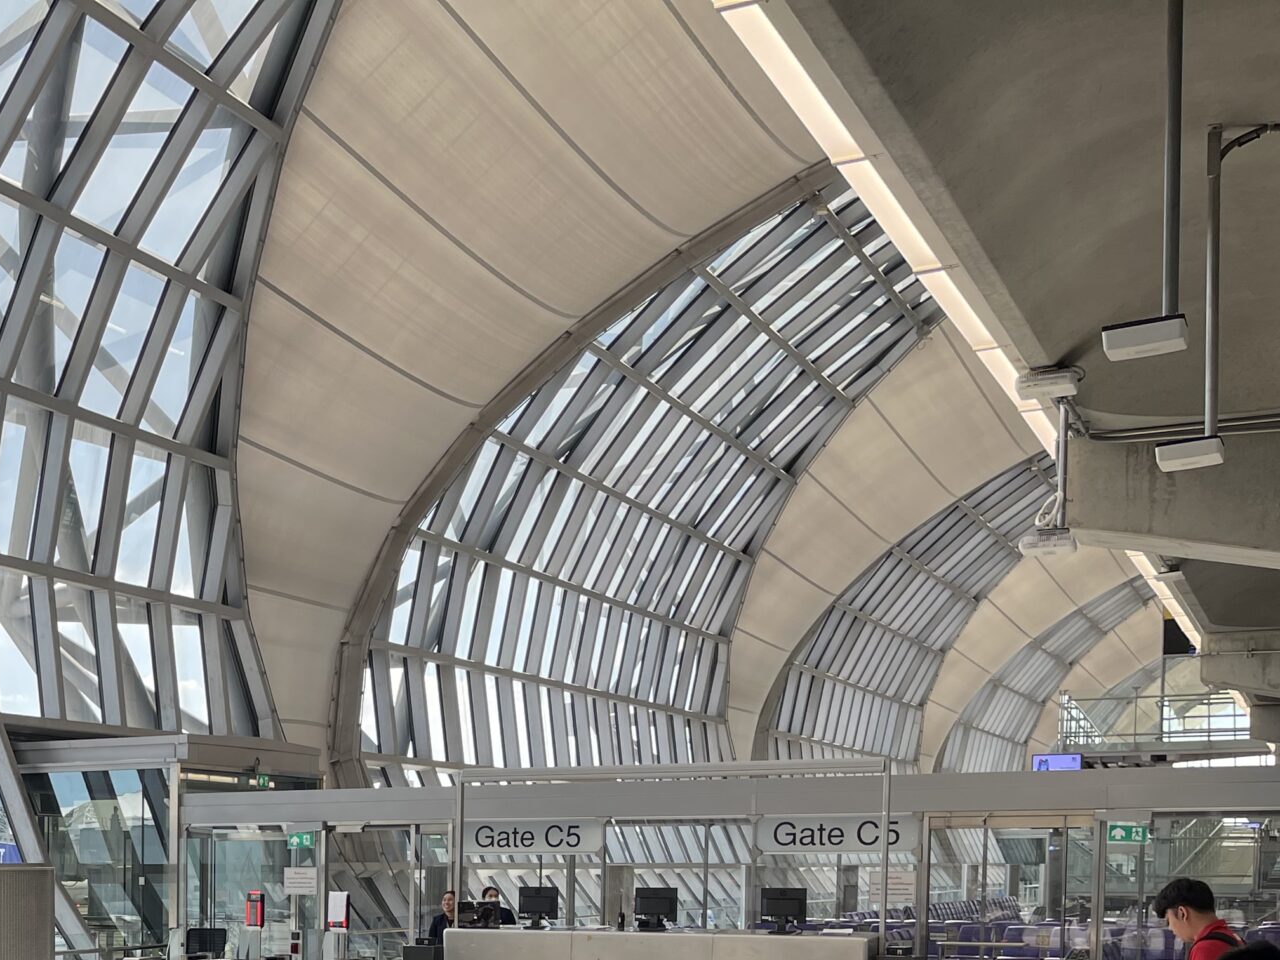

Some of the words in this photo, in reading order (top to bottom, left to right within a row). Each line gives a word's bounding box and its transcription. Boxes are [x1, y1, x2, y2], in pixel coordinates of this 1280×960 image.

[475, 825, 535, 848] Gate
[545, 825, 581, 848] C5
[773, 821, 845, 846] Gate
[857, 820, 900, 846] C5
